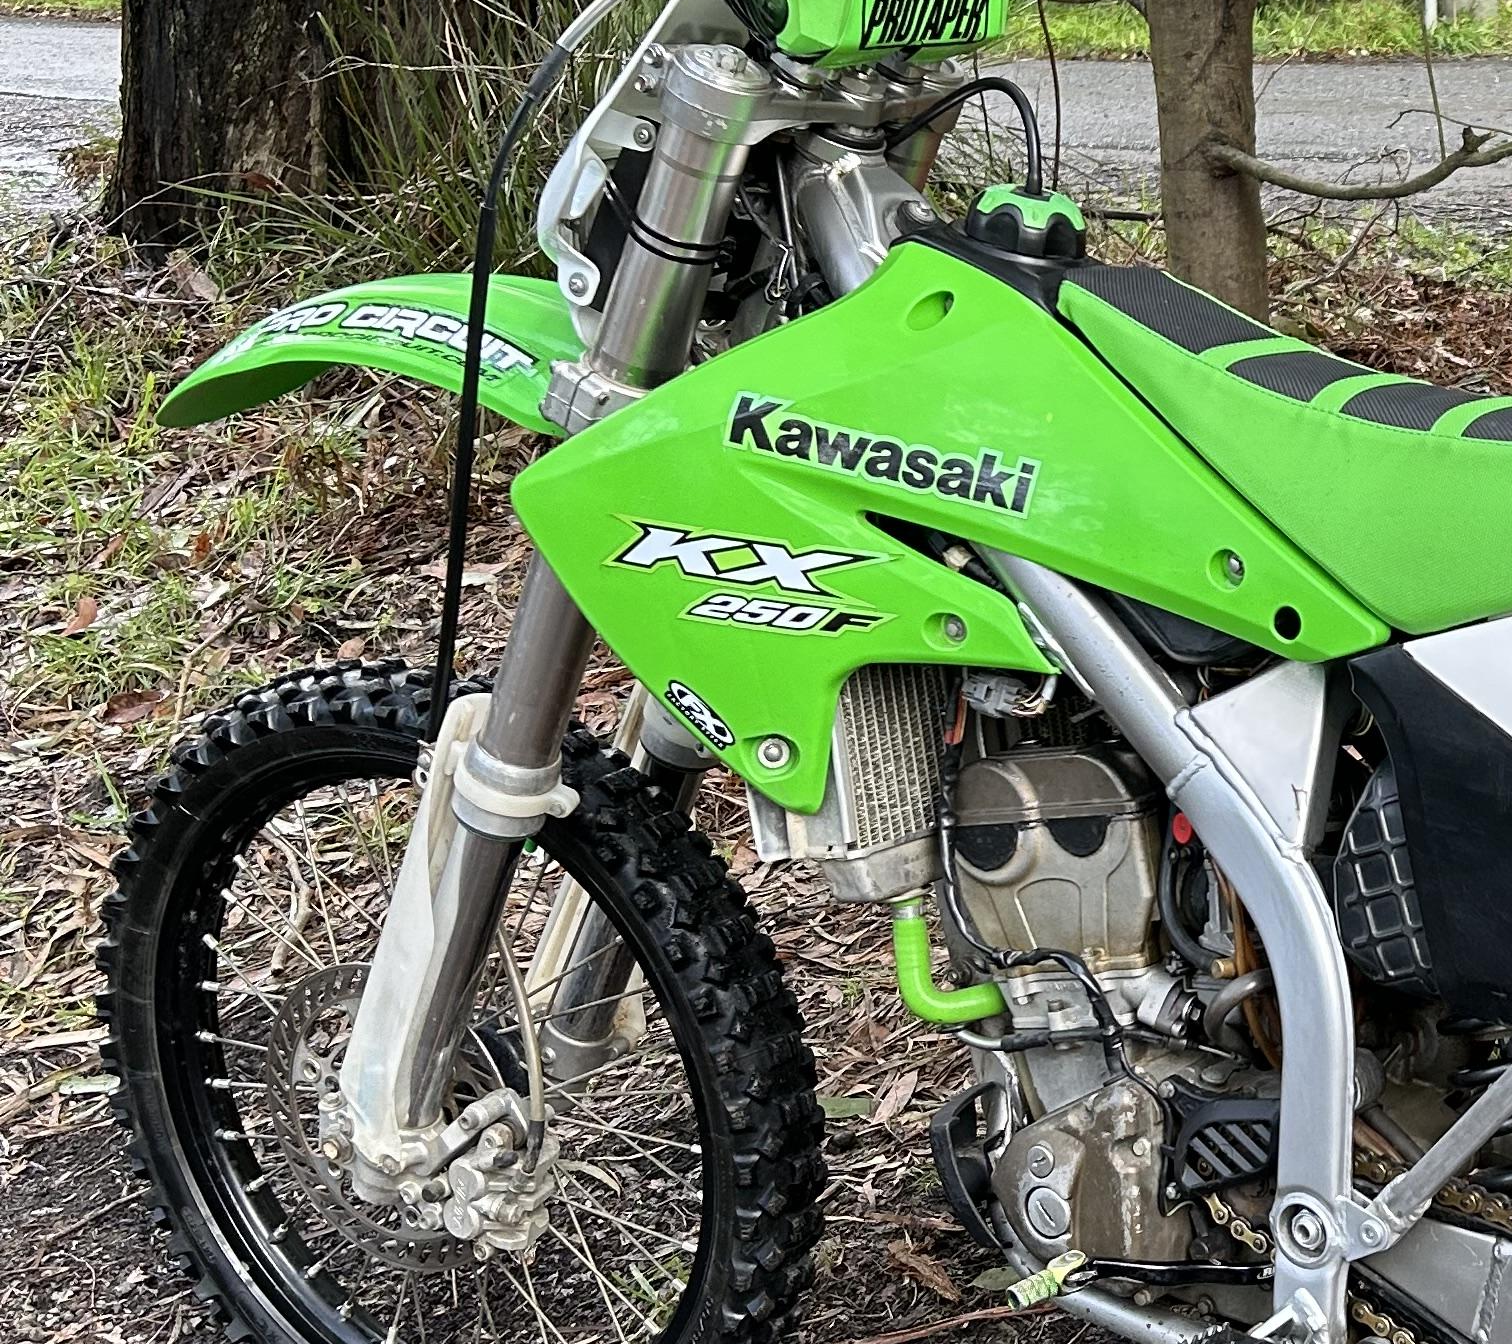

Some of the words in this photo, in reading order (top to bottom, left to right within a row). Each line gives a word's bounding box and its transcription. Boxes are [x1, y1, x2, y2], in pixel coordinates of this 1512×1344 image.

[340, 304, 539, 372] CIRCUIT
[728, 395, 1036, 514] Kawasaki
[609, 521, 886, 601] KX
[688, 593, 882, 633] 250F
